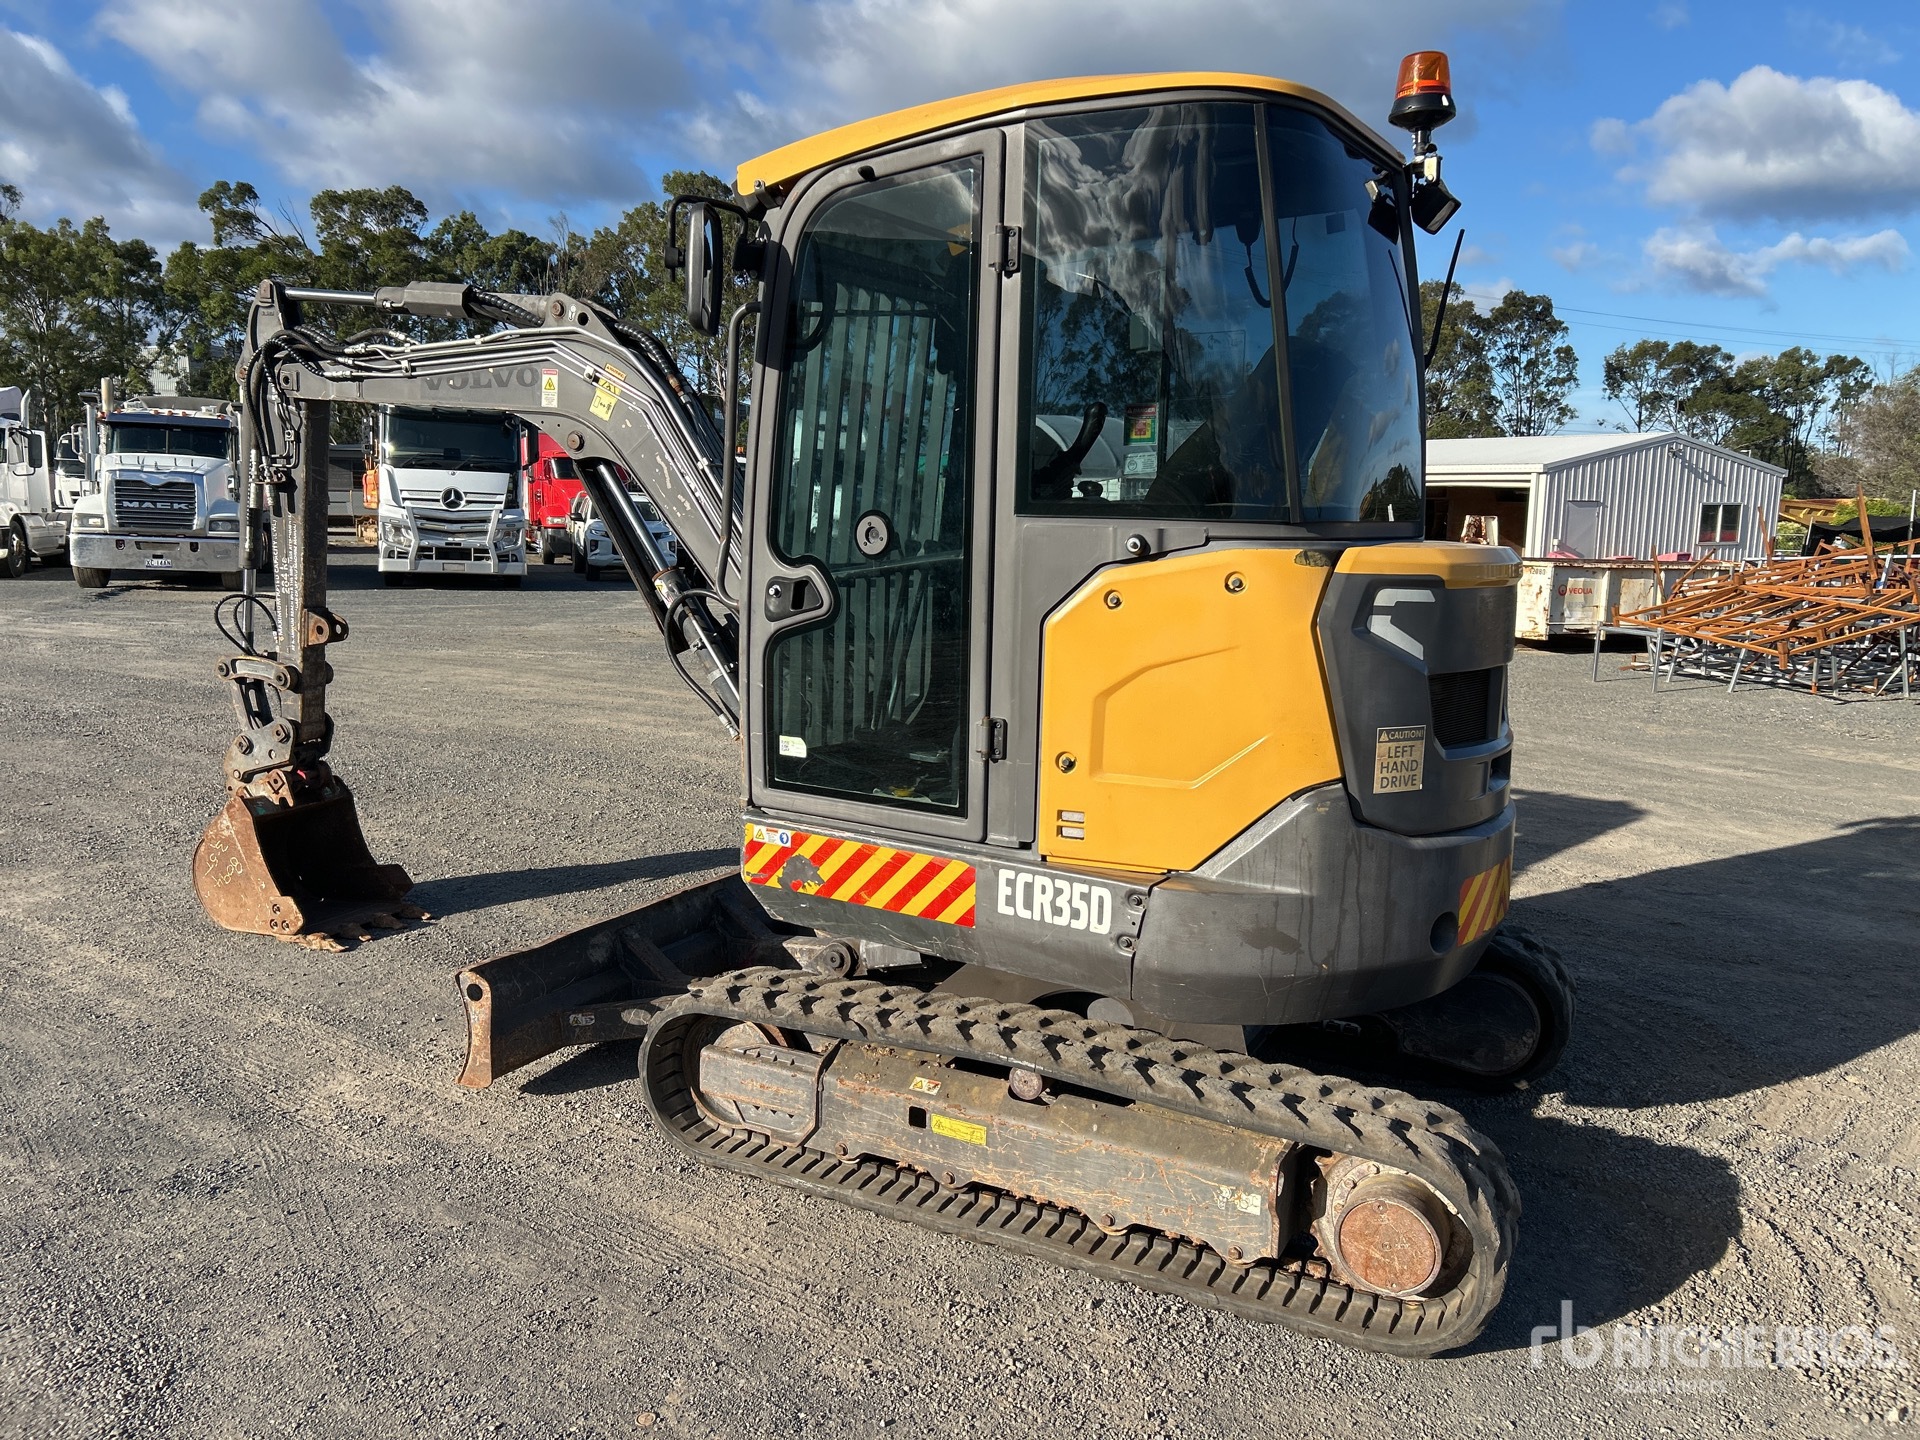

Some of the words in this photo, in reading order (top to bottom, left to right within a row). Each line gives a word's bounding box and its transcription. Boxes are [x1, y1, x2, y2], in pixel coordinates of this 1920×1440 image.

[425, 366, 539, 391] VOLVO
[122, 501, 189, 509] MACK
[1569, 587, 1593, 595] VEOLIA
[1388, 730, 1424, 740] CAUTION!
[1388, 745, 1415, 759] LEFT
[1380, 760, 1419, 774] HAND
[1380, 774, 1418, 789] DRIVE
[998, 868, 1112, 935] ECR35D
